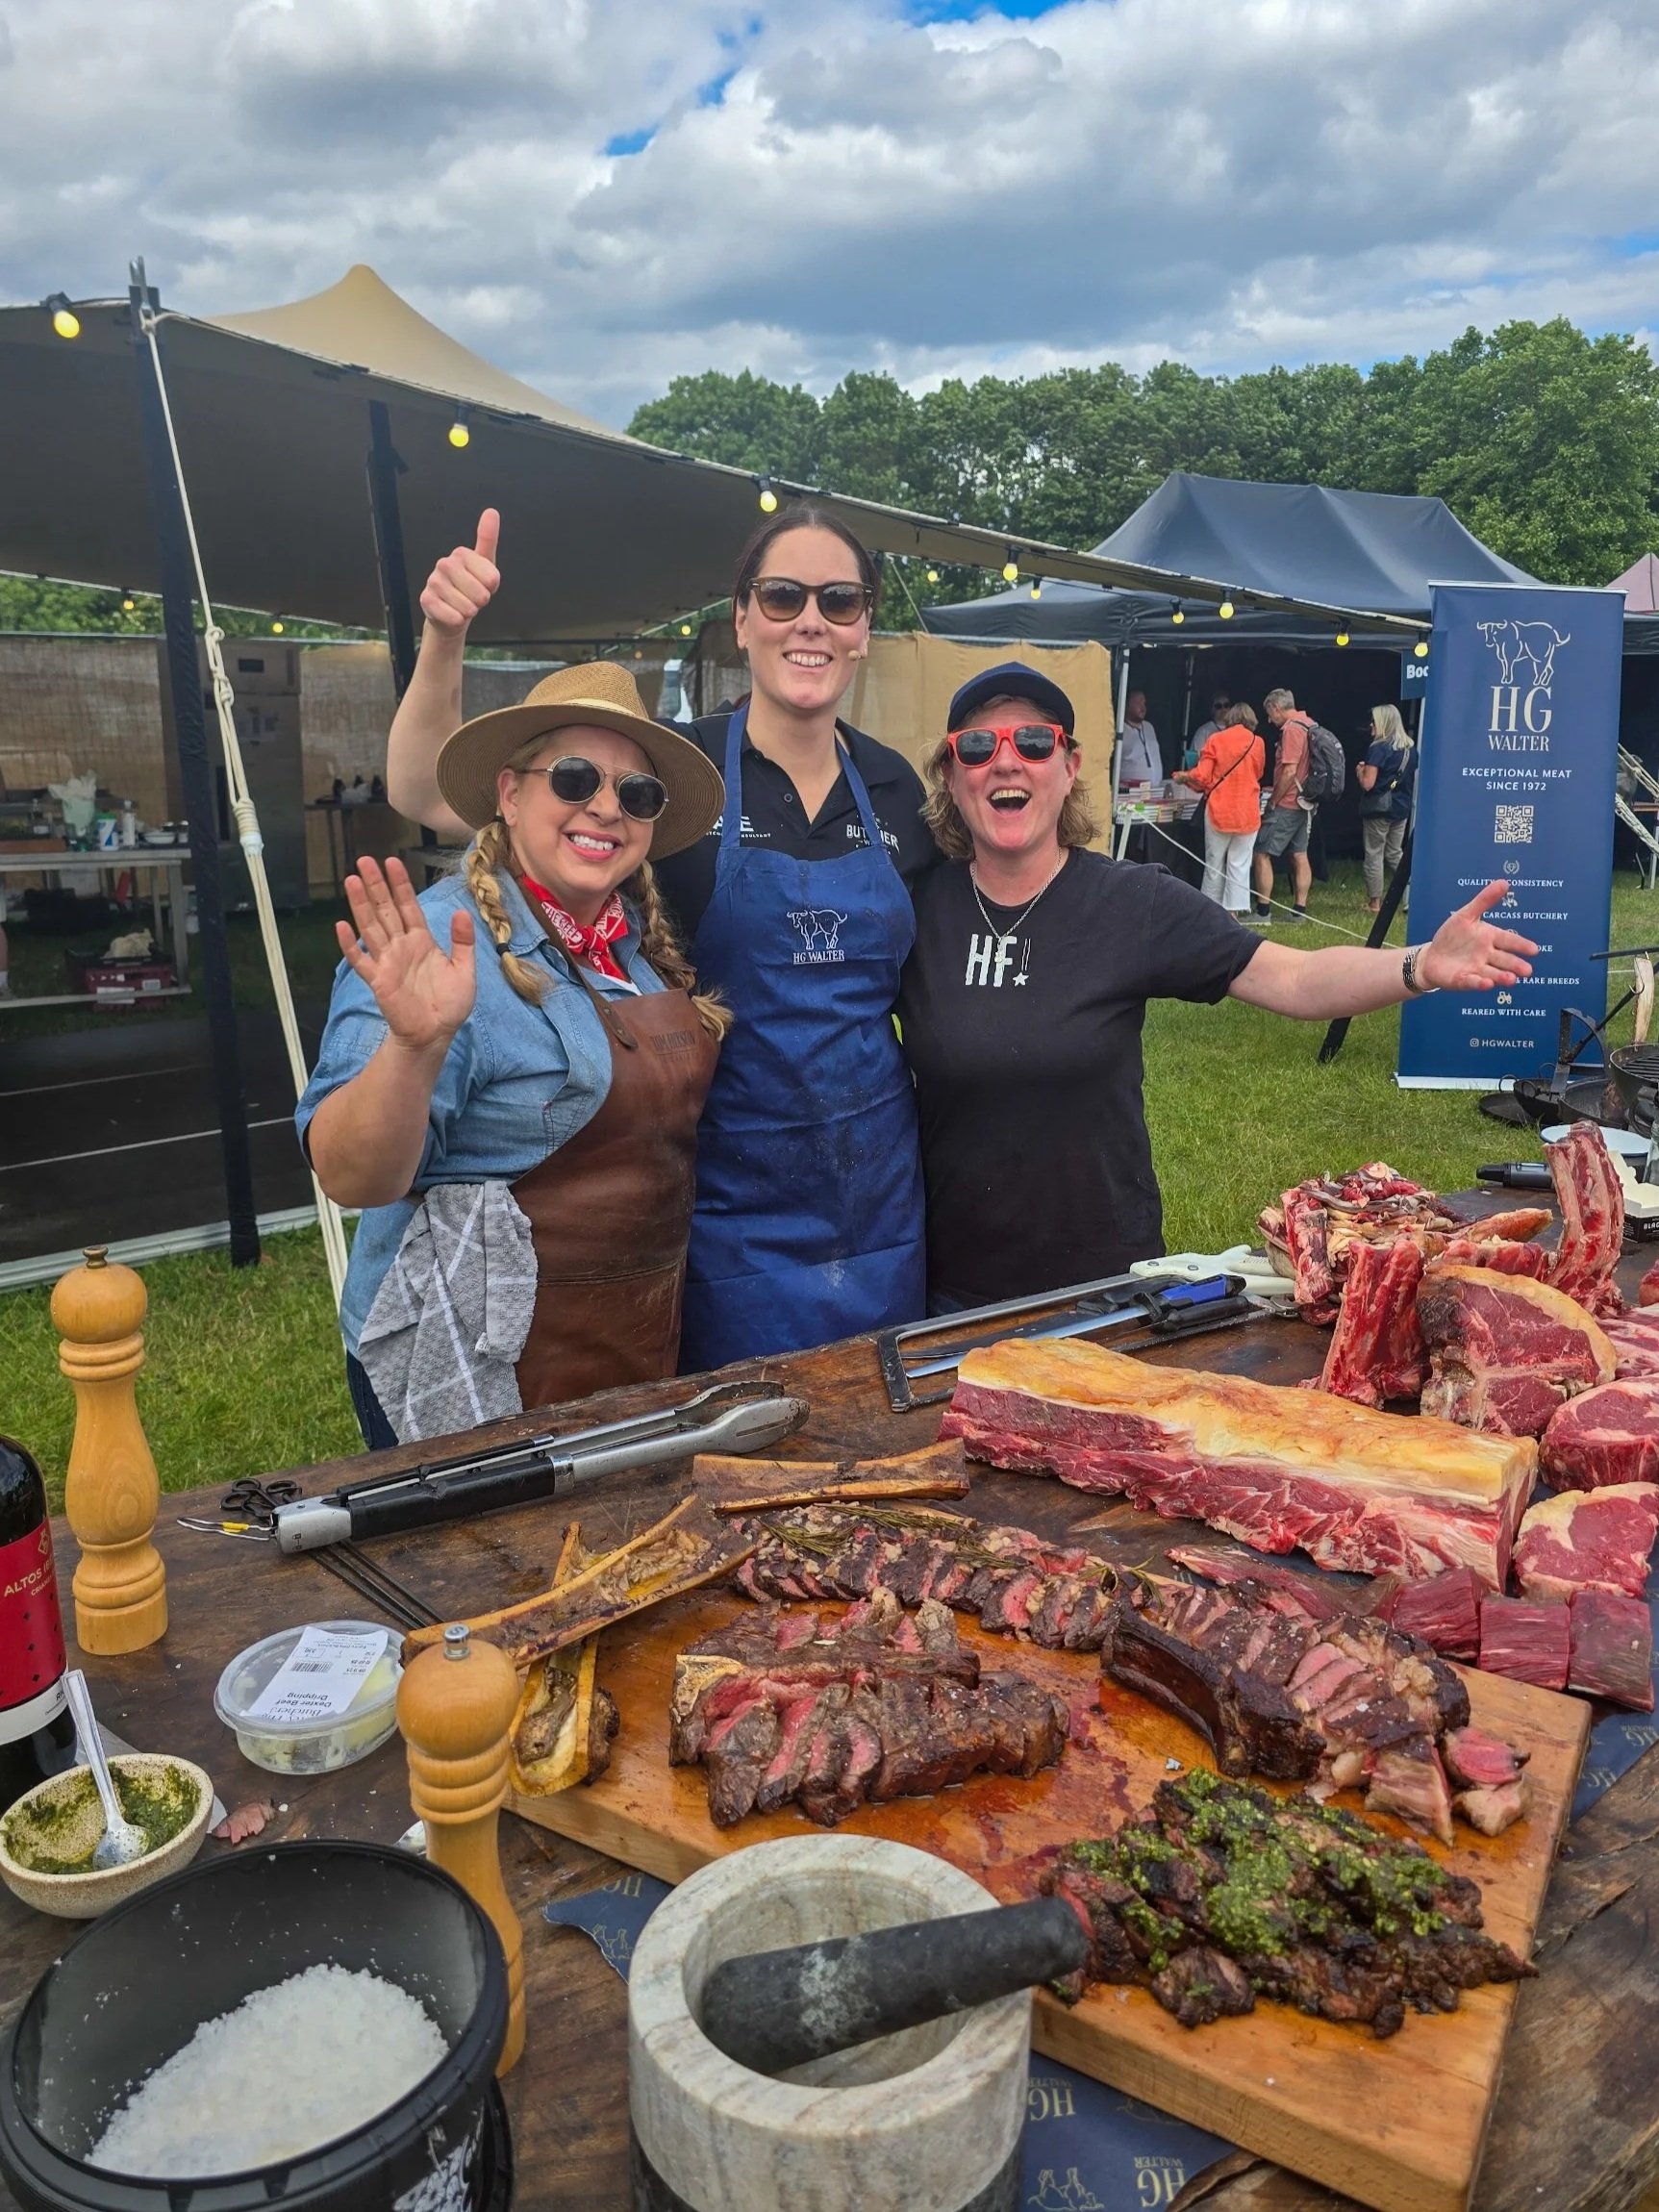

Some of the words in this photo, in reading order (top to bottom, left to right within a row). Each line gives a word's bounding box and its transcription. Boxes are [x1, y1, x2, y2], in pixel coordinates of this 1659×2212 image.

[1489, 687, 1552, 733] HG
[1489, 735, 1550, 752] WALTER
[1462, 767, 1539, 777] EXCEPTIONAL
[1543, 769, 1572, 778] MEAT
[1486, 781, 1519, 791] SINCE
[1522, 782, 1546, 791] 1972
[793, 952, 807, 963] HG
[808, 949, 844, 963] WALTER
[1481, 1040, 1535, 1048] HGWALTER
[4, 1568, 42, 1597] ALTOS
[287, 1692, 329, 1700] Dripping
[1028, 2088, 1077, 2122] HG
[1134, 2156, 1184, 2169] WALTER
[1138, 2169, 1185, 2207] HG
